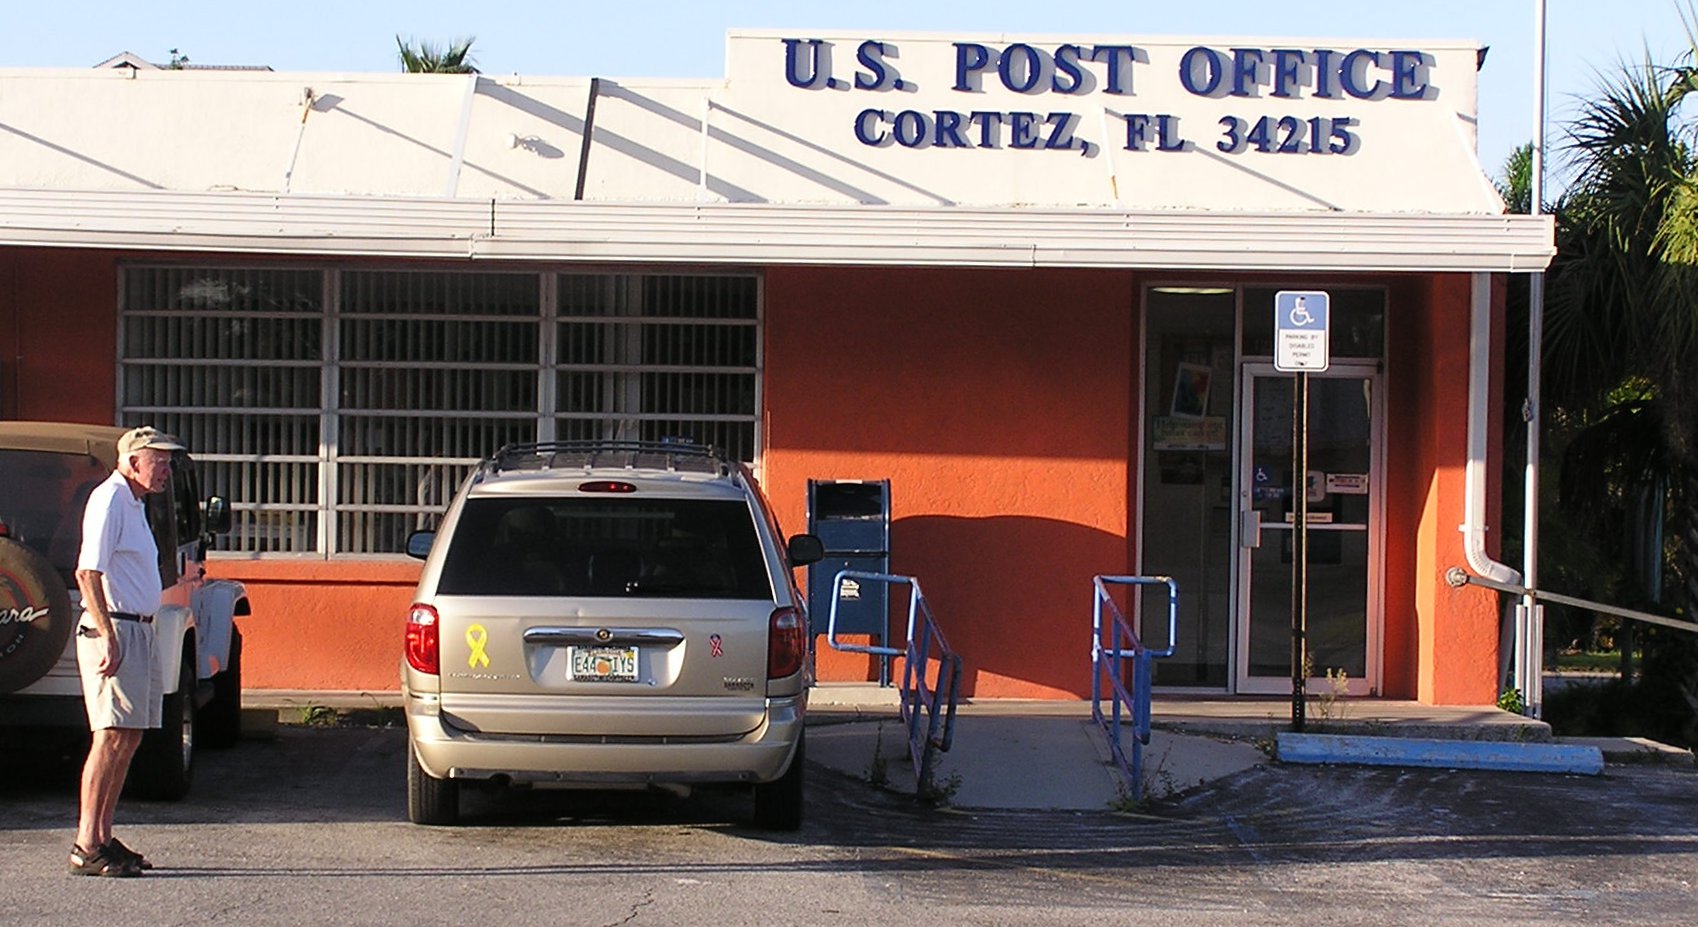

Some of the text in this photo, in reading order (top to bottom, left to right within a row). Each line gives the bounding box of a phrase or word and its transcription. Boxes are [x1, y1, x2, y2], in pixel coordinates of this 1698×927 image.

[781, 38, 1427, 99] U.S. POST OFFICE
[854, 108, 1351, 157] CORTEZ, FL 34215
[575, 657, 596, 673] E44
